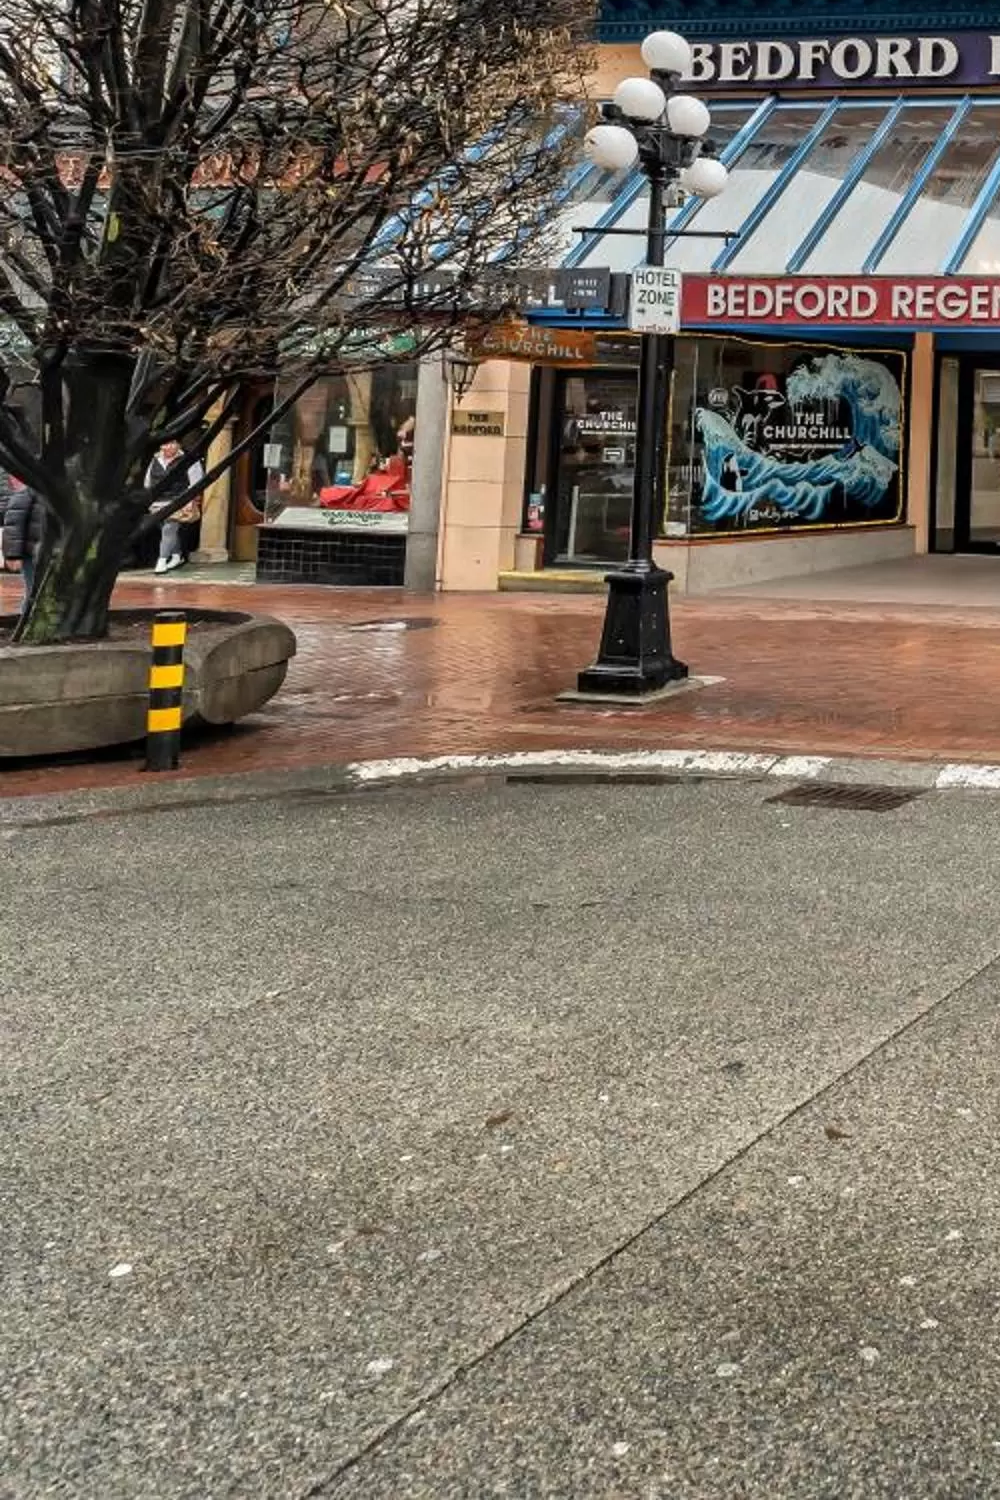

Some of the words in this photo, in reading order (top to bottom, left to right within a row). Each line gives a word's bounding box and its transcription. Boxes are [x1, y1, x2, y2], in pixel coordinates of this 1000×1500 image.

[680, 37, 959, 81] BEDFORD
[635, 271, 678, 287] HOTEL
[638, 289, 675, 306] ZONE
[706, 283, 878, 319] BEDFORD
[482, 333, 584, 360] CHURCHILL
[576, 420, 637, 431] CHURCHIL
[794, 412, 825, 426] THE
[762, 426, 852, 440] CHURCHILL
